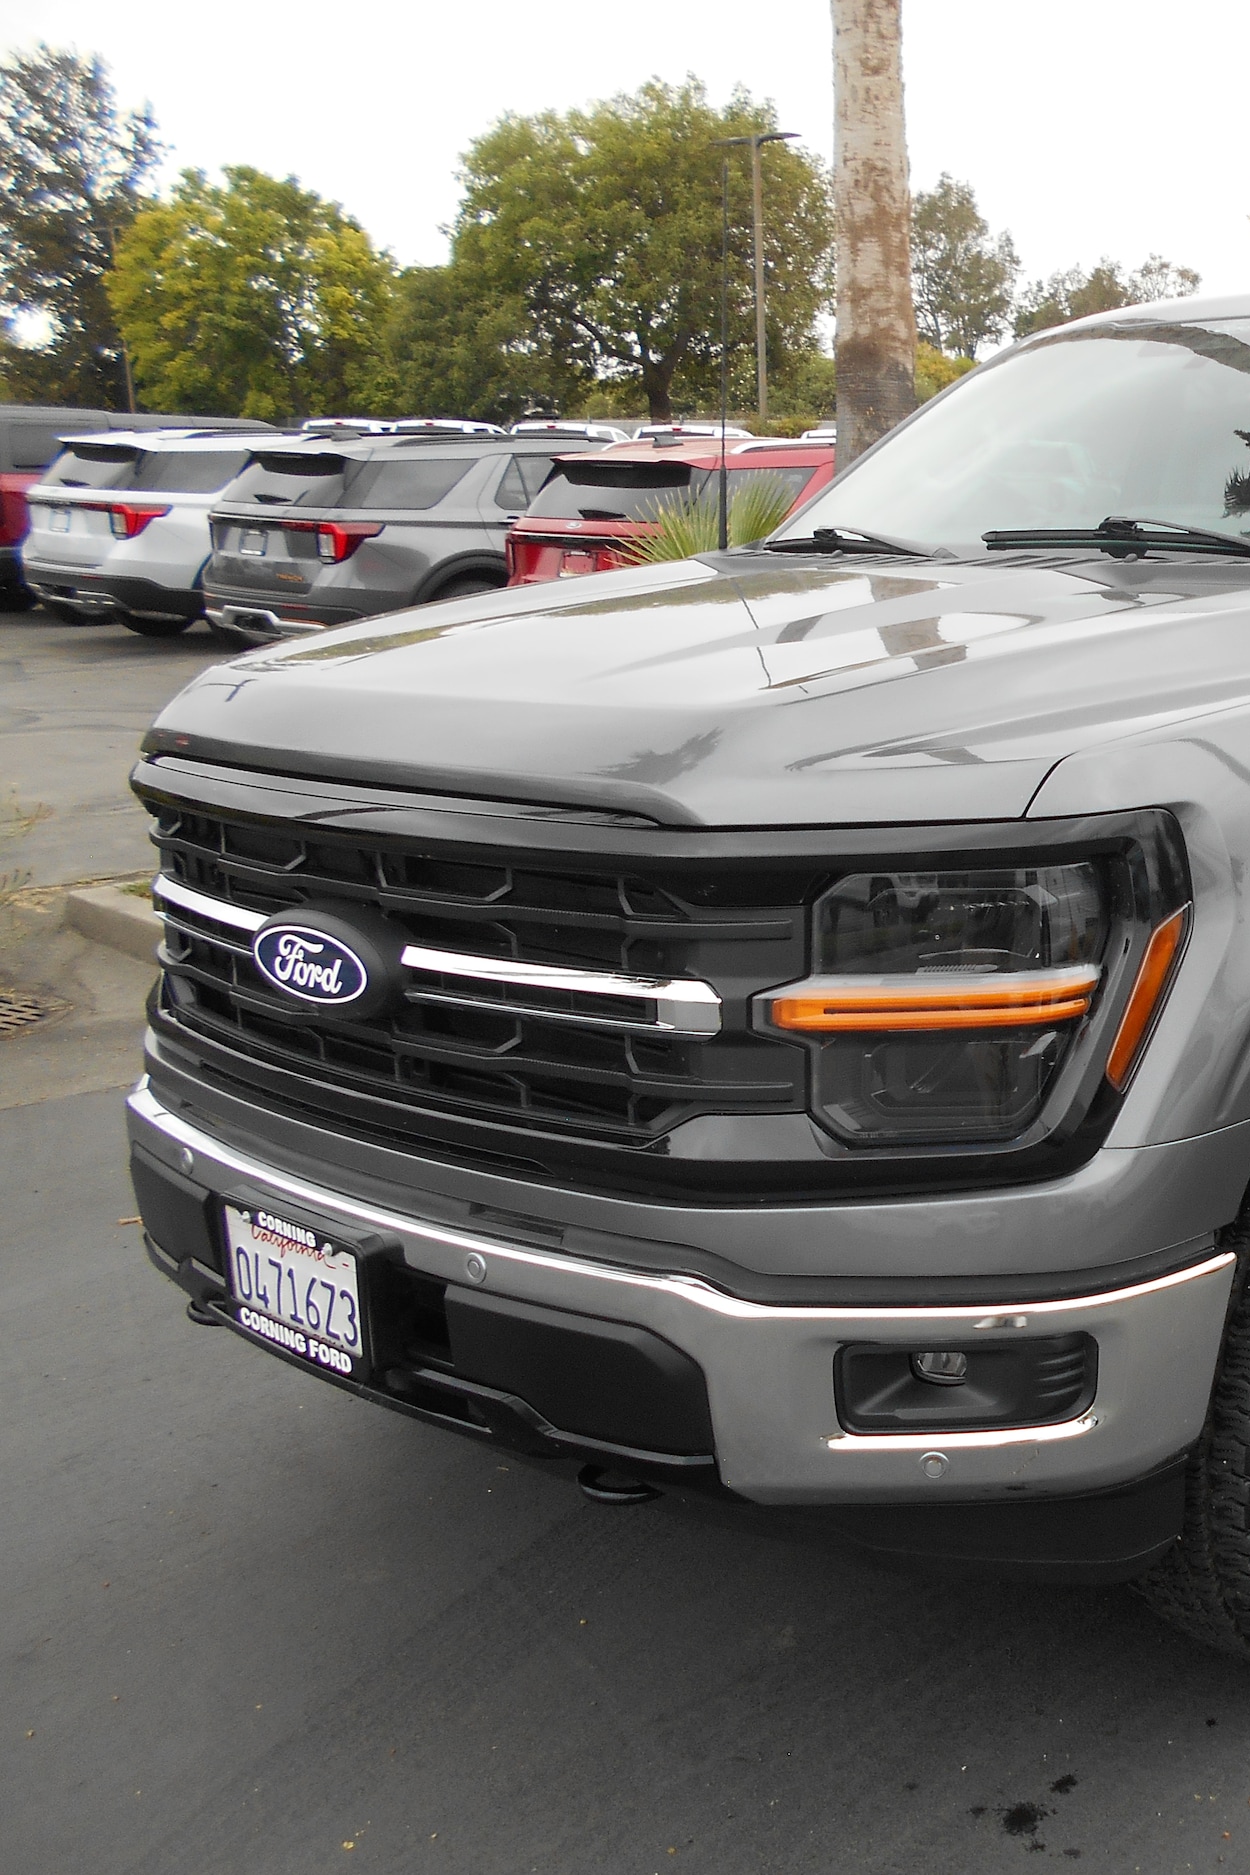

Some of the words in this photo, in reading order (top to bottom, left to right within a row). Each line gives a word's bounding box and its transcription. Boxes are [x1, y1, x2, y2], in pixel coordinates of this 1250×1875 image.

[274, 934, 343, 994] Ford
[257, 1211, 317, 1248] CORNING
[236, 1246, 358, 1347] 04716Z3
[240, 1307, 306, 1353] CORNING
[309, 1339, 352, 1373] FORD
